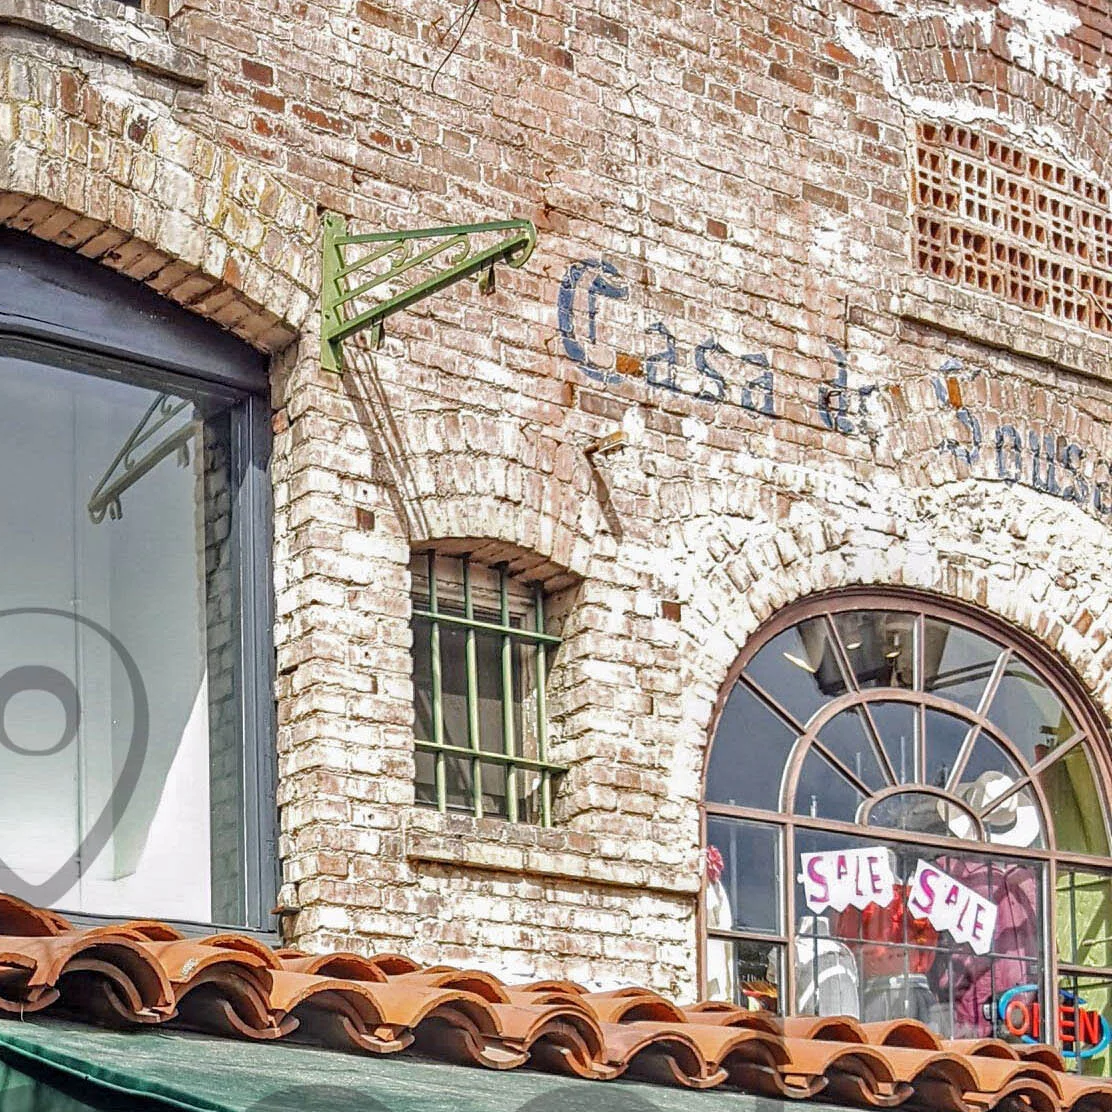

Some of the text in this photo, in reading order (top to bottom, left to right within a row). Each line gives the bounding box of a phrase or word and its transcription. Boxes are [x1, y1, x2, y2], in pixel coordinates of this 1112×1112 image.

[558, 258, 774, 420] Casa
[807, 855, 884, 903] SALE
[911, 867, 985, 941] SALE
